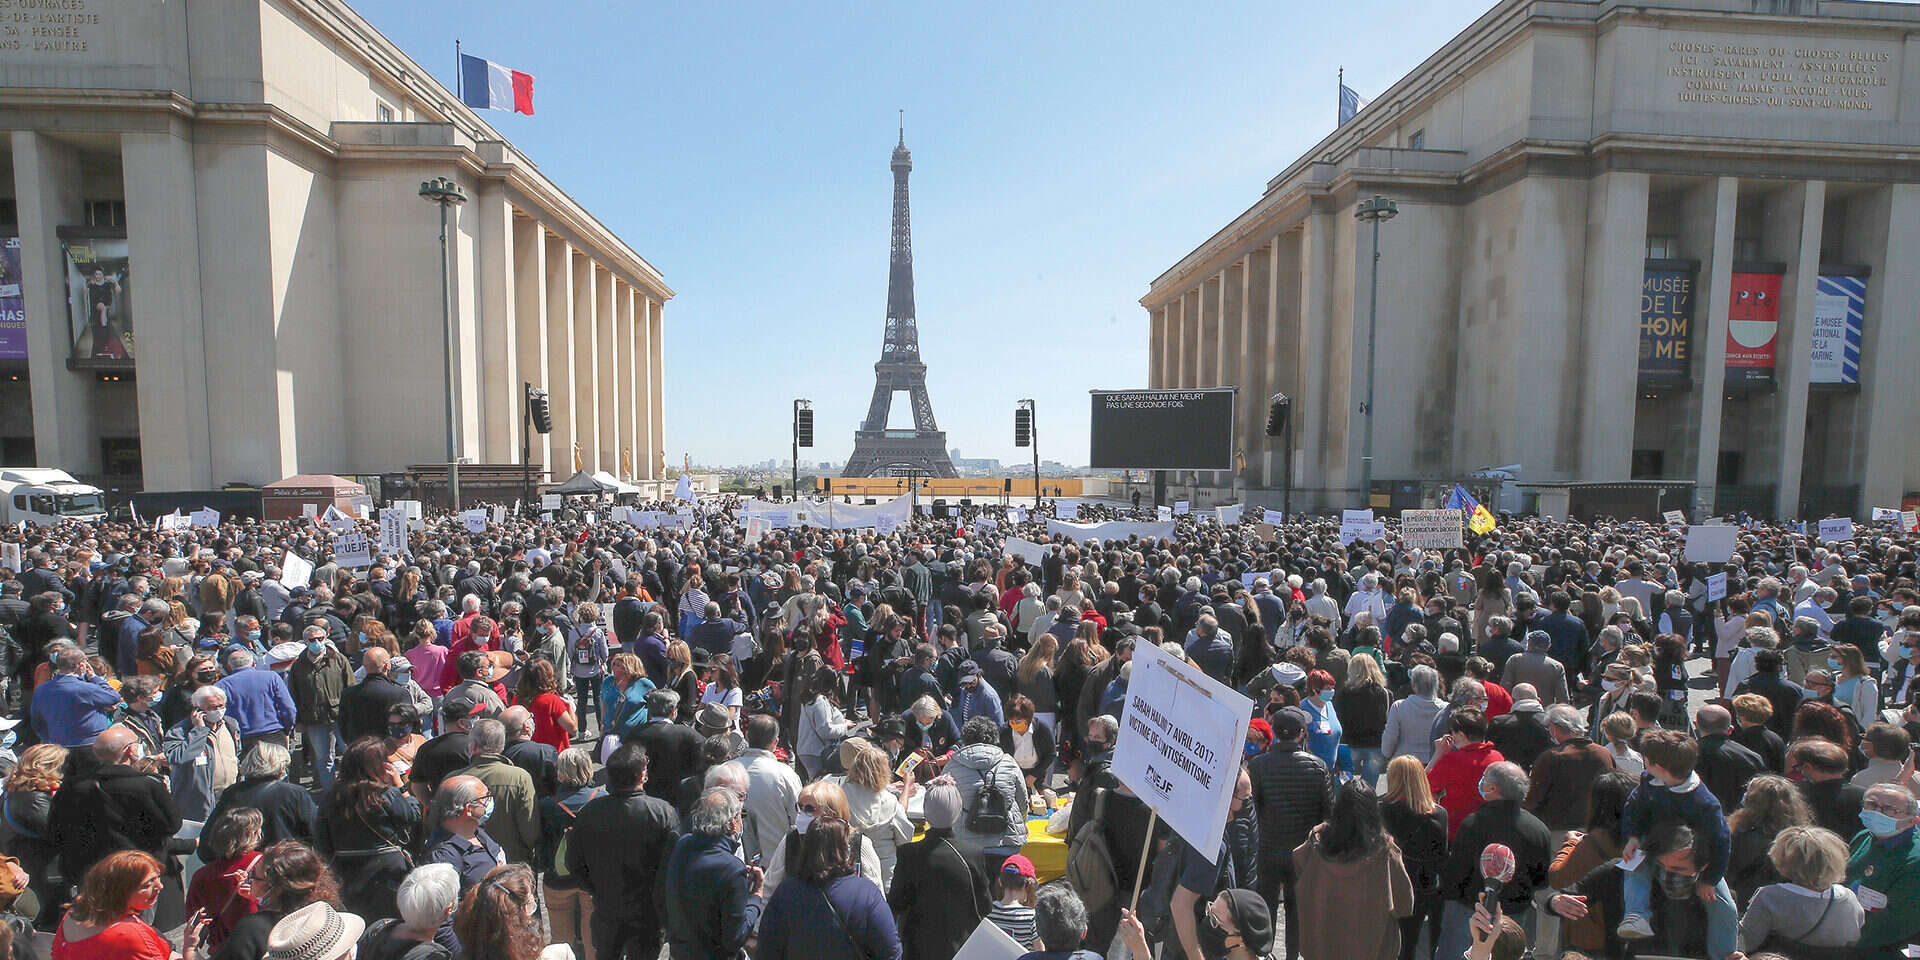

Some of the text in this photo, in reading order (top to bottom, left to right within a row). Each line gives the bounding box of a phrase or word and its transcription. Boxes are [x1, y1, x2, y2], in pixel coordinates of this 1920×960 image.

[1669, 42, 1715, 54] CHOSES
[1725, 45, 1759, 56] RARES
[1794, 48, 1840, 60] CHOSES
[1680, 55, 1698, 65] ICI
[1713, 57, 1785, 69] SAVAMMENT
[1667, 66, 1748, 80] INSTRUISENT
[1823, 75, 1888, 87] REGARDER
[1687, 80, 1728, 91] COMME
[1785, 85, 1829, 96] ENCORE
[1840, 88, 1868, 98] VUES
[1721, 94, 1761, 105] CHOSES
[1641, 276, 1690, 293] MUSÉE
[1640, 294, 1688, 314] DE L'
[1640, 317, 1688, 337] HOM
[1655, 340, 1686, 359] ME
[1106, 401, 1119, 409] PAS
[1120, 401, 1134, 409] UNE
[1135, 401, 1167, 409] SECONDE
[1169, 393, 1179, 401] NE
[1180, 393, 1204, 401] MEURT
[345, 542, 367, 553] UEJF
[1129, 714, 1151, 741] VICTIME
[1151, 731, 1159, 747] DE
[1132, 696, 1151, 718] SARAH
[1167, 722, 1173, 736] 7
[1173, 727, 1193, 752] AVRIL
[1194, 742, 1214, 765] 2017
